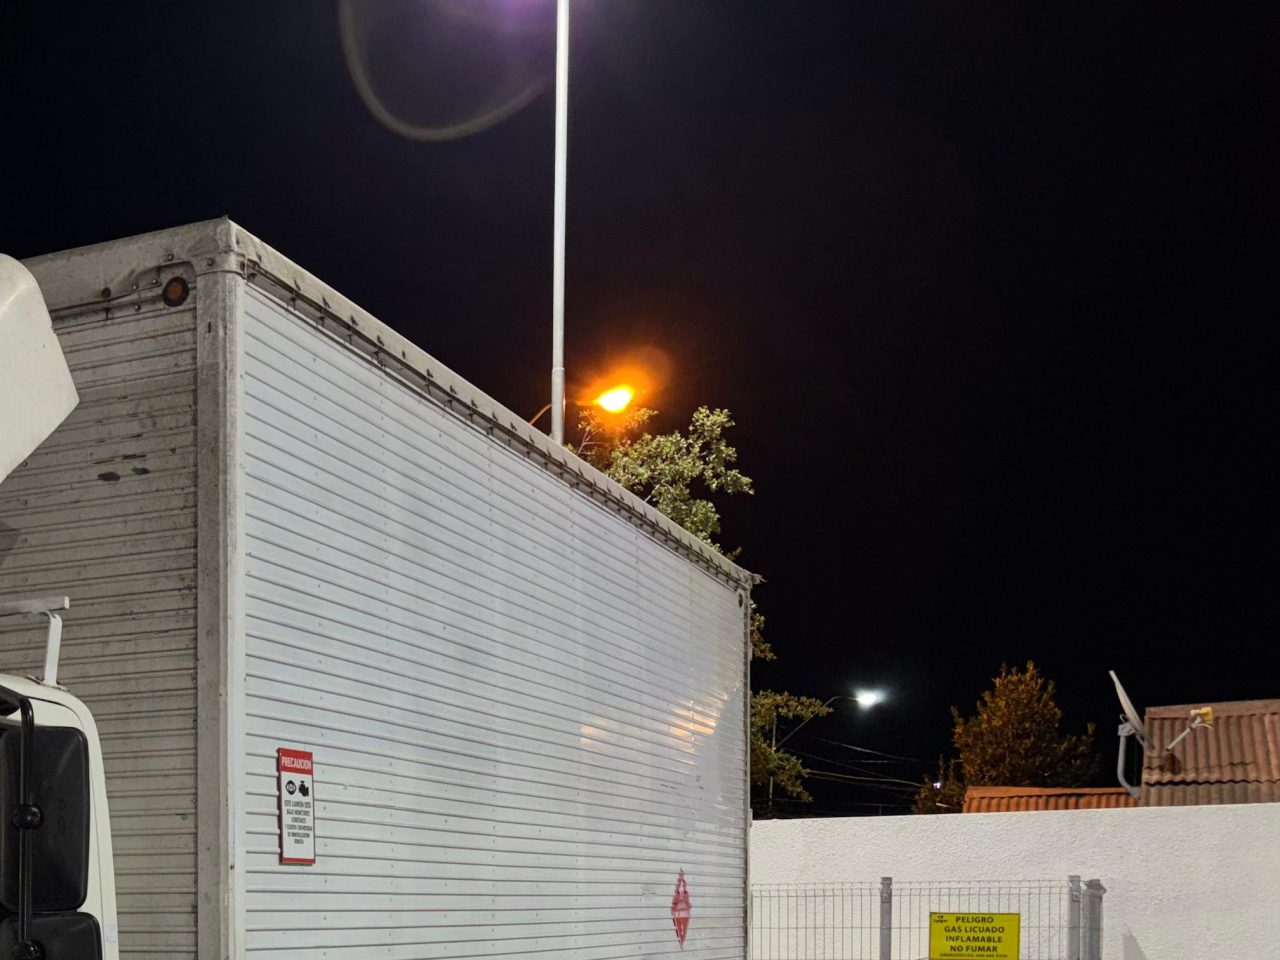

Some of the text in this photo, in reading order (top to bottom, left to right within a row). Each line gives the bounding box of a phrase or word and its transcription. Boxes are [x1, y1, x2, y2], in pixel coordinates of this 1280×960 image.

[955, 916, 994, 924] PELIGRO
[964, 926, 1005, 934] LICUADO
[945, 935, 1003, 943] INFLAMABLE
[965, 945, 998, 953] FUMAR
